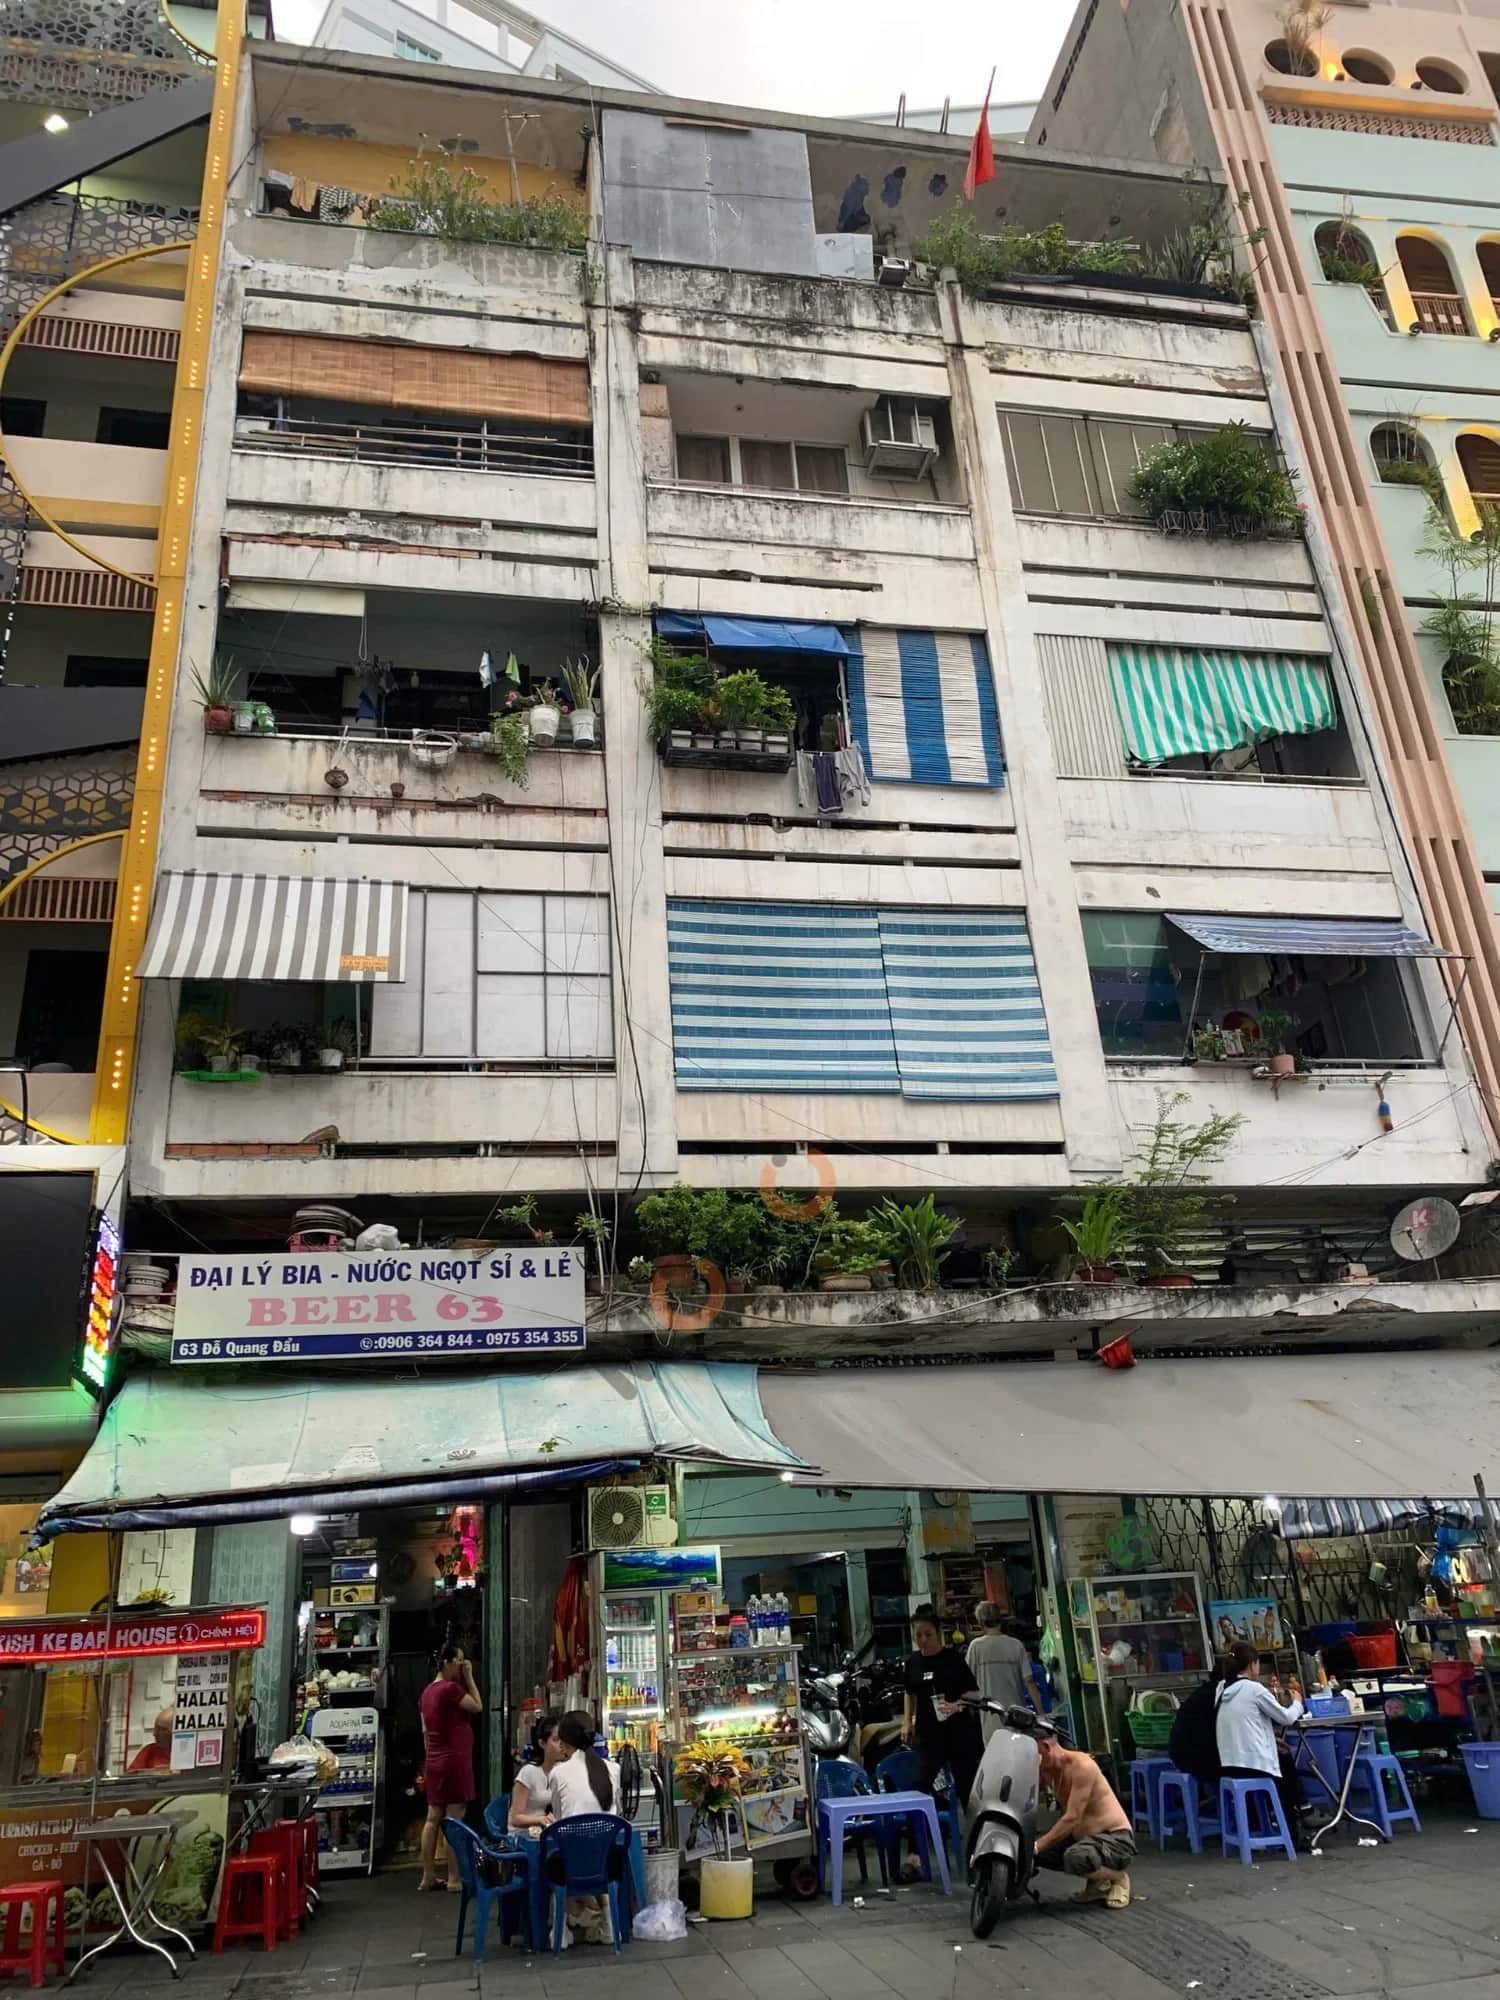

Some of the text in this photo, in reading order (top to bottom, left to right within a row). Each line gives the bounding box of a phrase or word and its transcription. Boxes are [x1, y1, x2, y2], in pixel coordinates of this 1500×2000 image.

[190, 1266, 233, 1291] ĐẠI
[242, 1260, 272, 1286] LÝ
[282, 1265, 322, 1285] BIA
[347, 1257, 412, 1283] NƯỚC
[420, 1260, 482, 1284] NGỌT
[490, 1252, 512, 1279] SỈ
[519, 1258, 537, 1278] &
[544, 1251, 571, 1278] LẺ
[245, 1293, 504, 1327] BEER 63
[179, 1342, 198, 1356] 63
[202, 1339, 221, 1355] Đỗ
[225, 1341, 269, 1356] Quang
[417, 1334, 443, 1348] 364
[447, 1333, 473, 1347] 844
[485, 1332, 520, 1346] 0975
[523, 1331, 549, 1344] 354
[553, 1330, 578, 1343] 355
[115, 1625, 177, 1647] HOUSE
[176, 1691, 228, 1708] HALAL
[175, 1711, 225, 1730] HALAL
